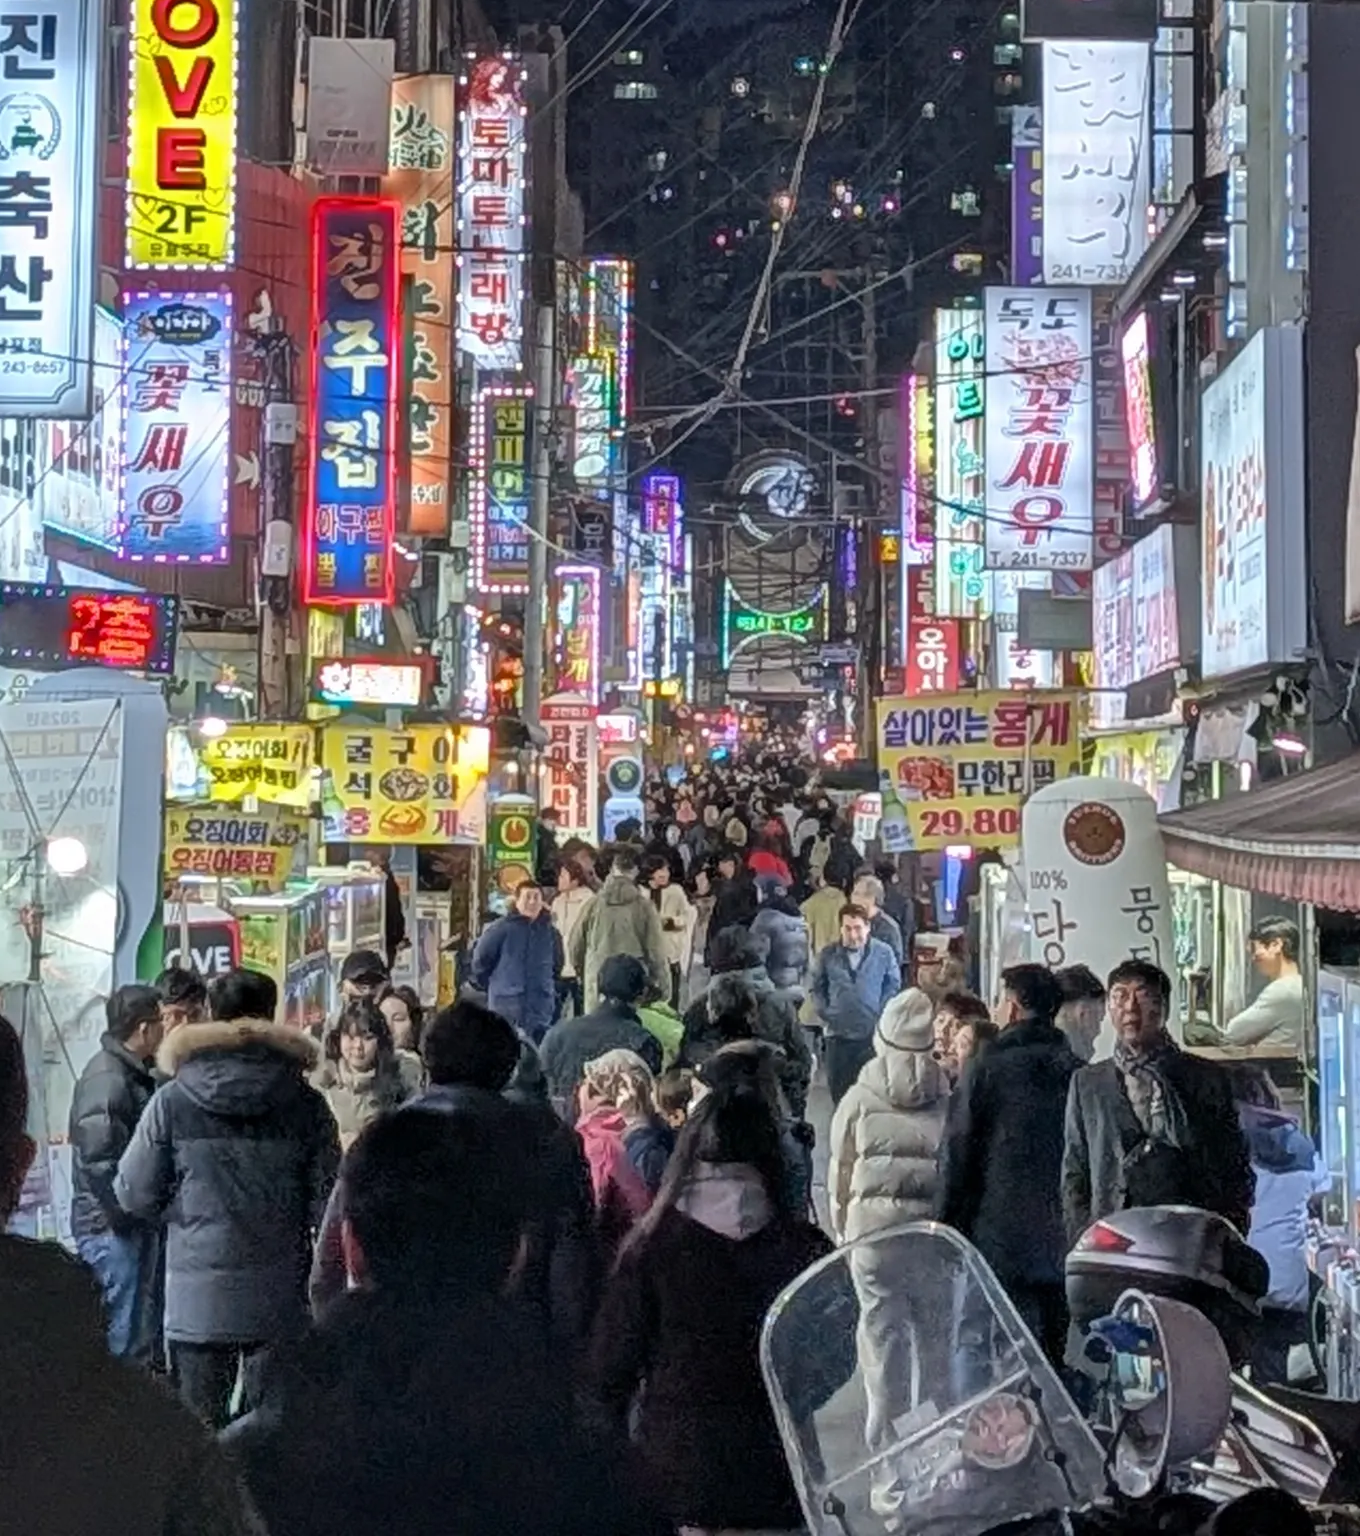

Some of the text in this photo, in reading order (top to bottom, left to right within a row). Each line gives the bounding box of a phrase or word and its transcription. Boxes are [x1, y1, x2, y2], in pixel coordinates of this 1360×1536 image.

[155, 206, 207, 235] 2F
[470, 117, 514, 349] 토마토노래방
[997, 298, 1079, 330] 독도
[324, 224, 389, 489] 진주집
[134, 360, 187, 541] 꽃새우
[997, 386, 1073, 546] 꽃새우
[1011, 550, 1087, 565] 241-7337
[883, 700, 1074, 749] 살아있는 홍게
[1031, 871, 1068, 890] 100%
